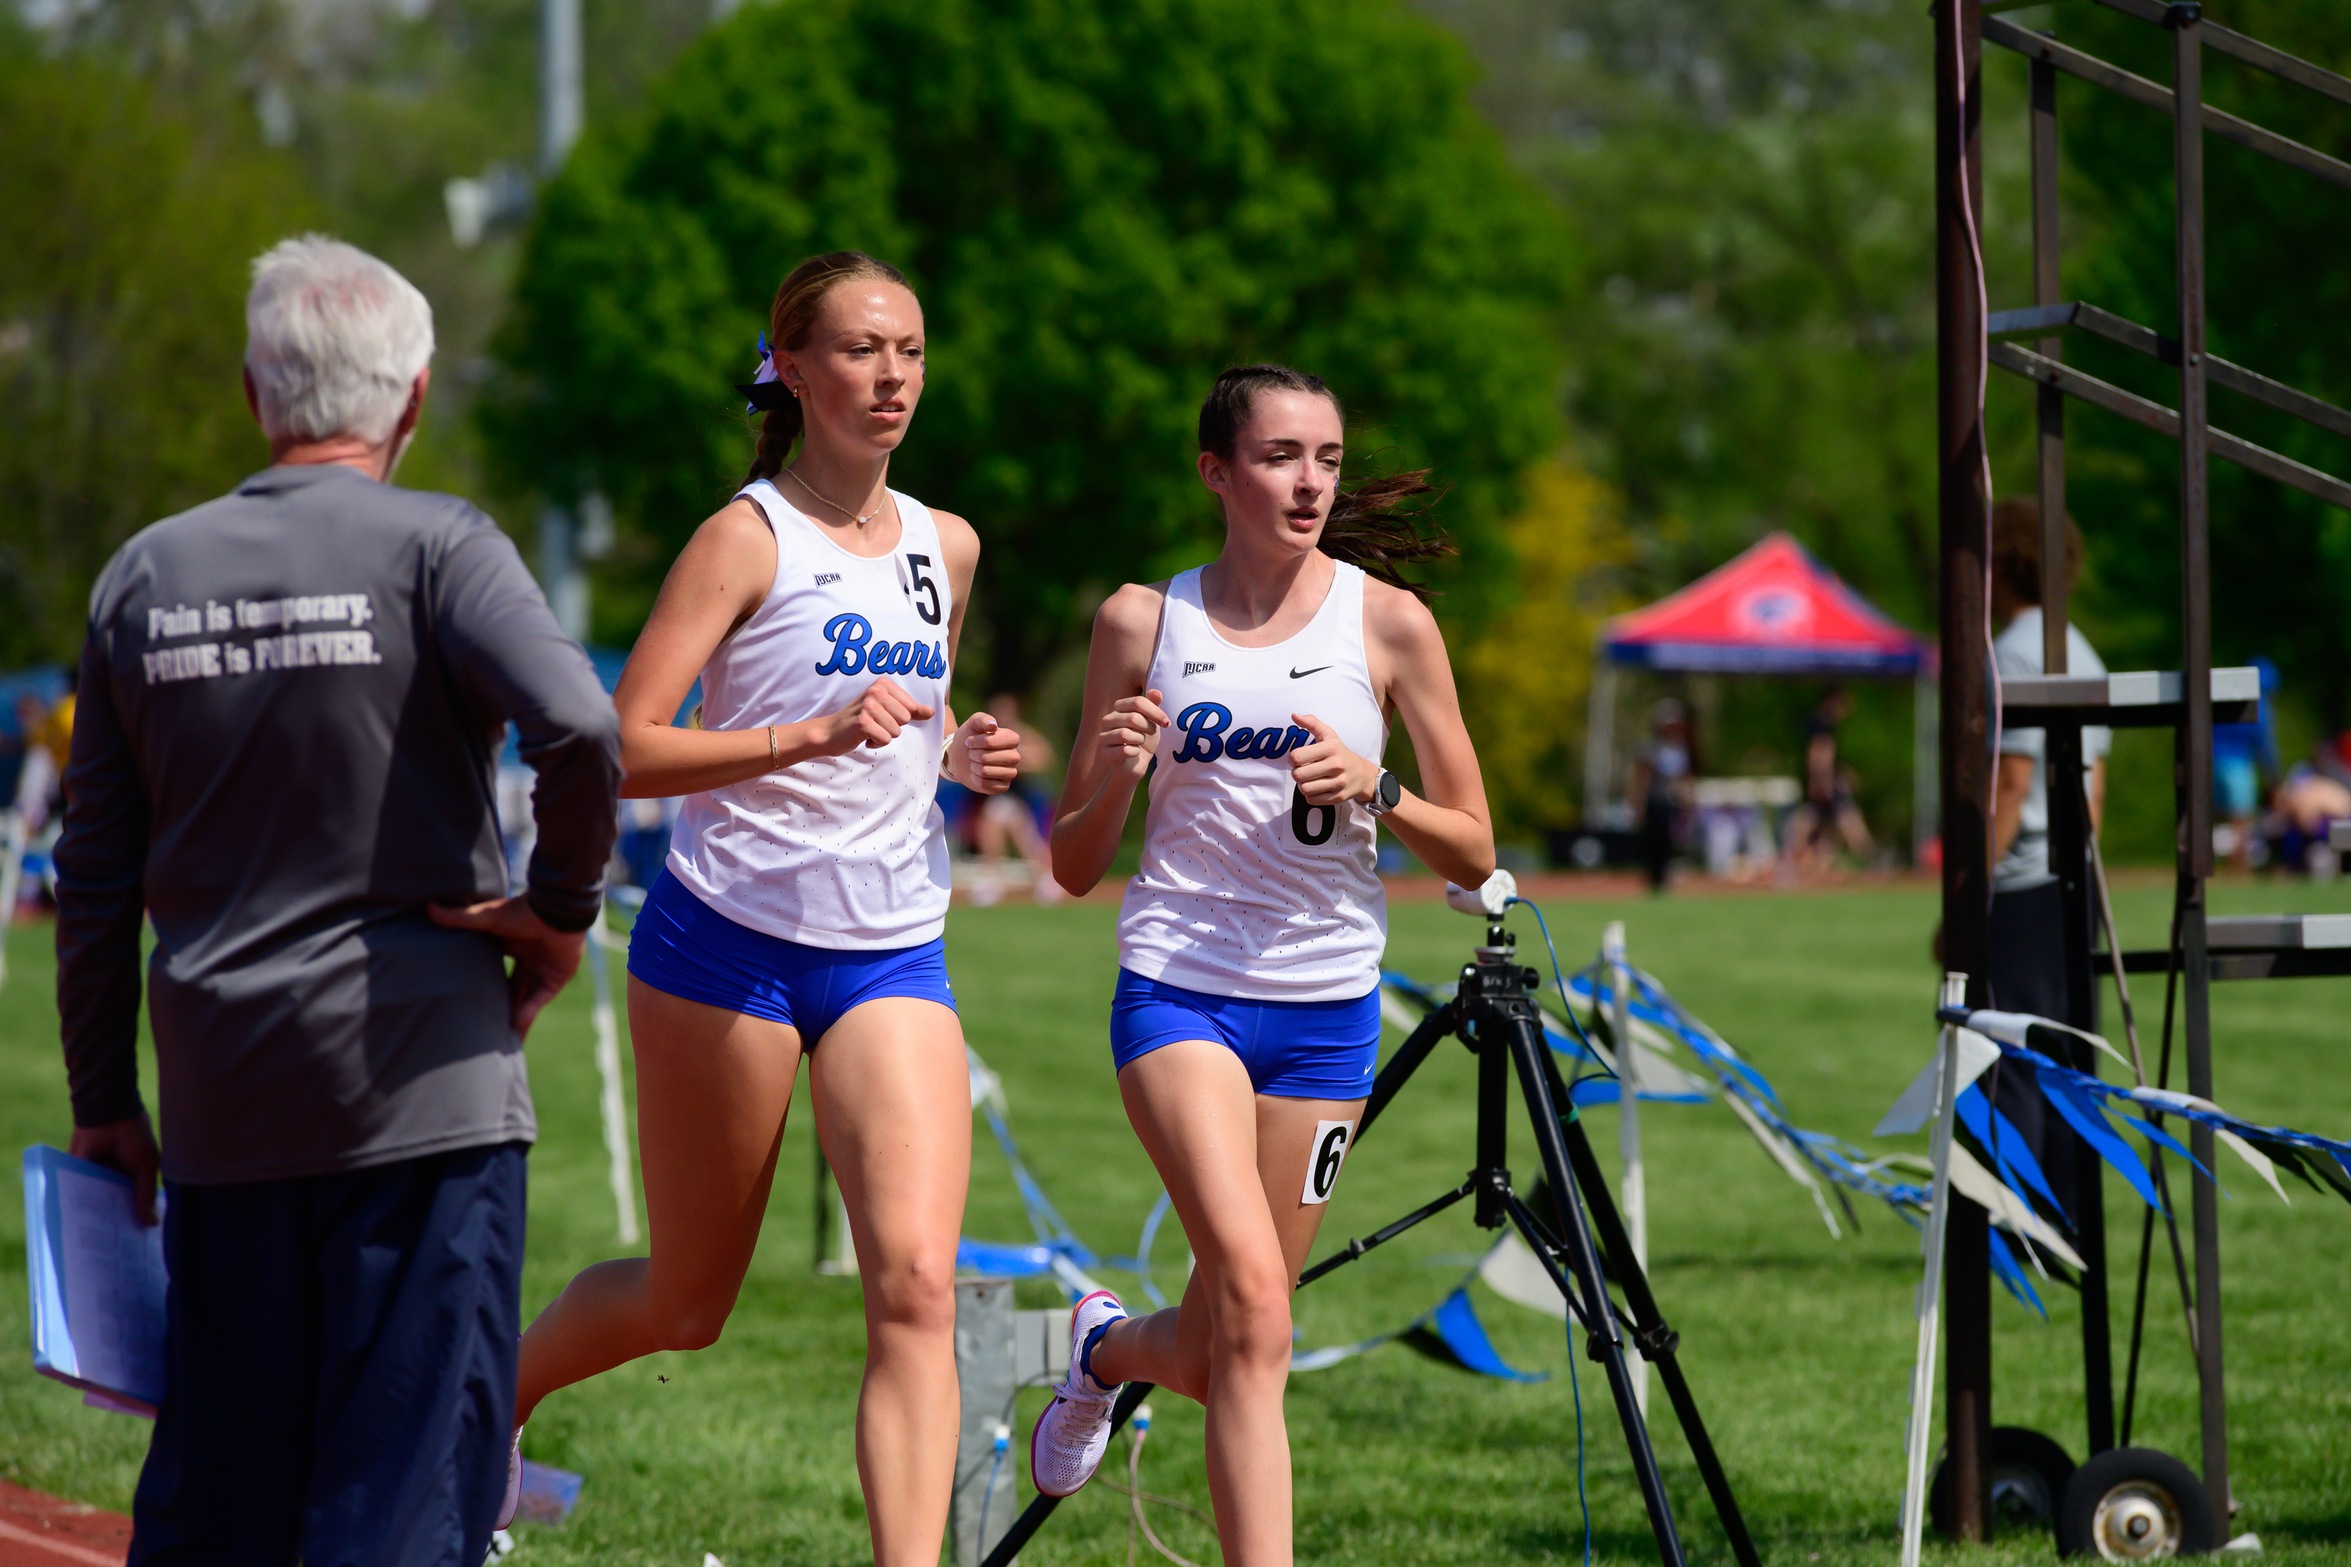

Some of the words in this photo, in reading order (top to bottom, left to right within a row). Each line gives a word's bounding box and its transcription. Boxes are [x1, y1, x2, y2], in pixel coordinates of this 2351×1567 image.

[206, 599, 232, 632] is
[235, 594, 374, 630] temporary.
[906, 553, 942, 626] 5
[142, 643, 222, 685] PRIDE
[224, 642, 251, 675] is
[815, 612, 947, 679] Bears
[1183, 662, 1215, 676] NJCAA
[1172, 701, 1317, 763] Bear
[1313, 1126, 1347, 1198] 6
